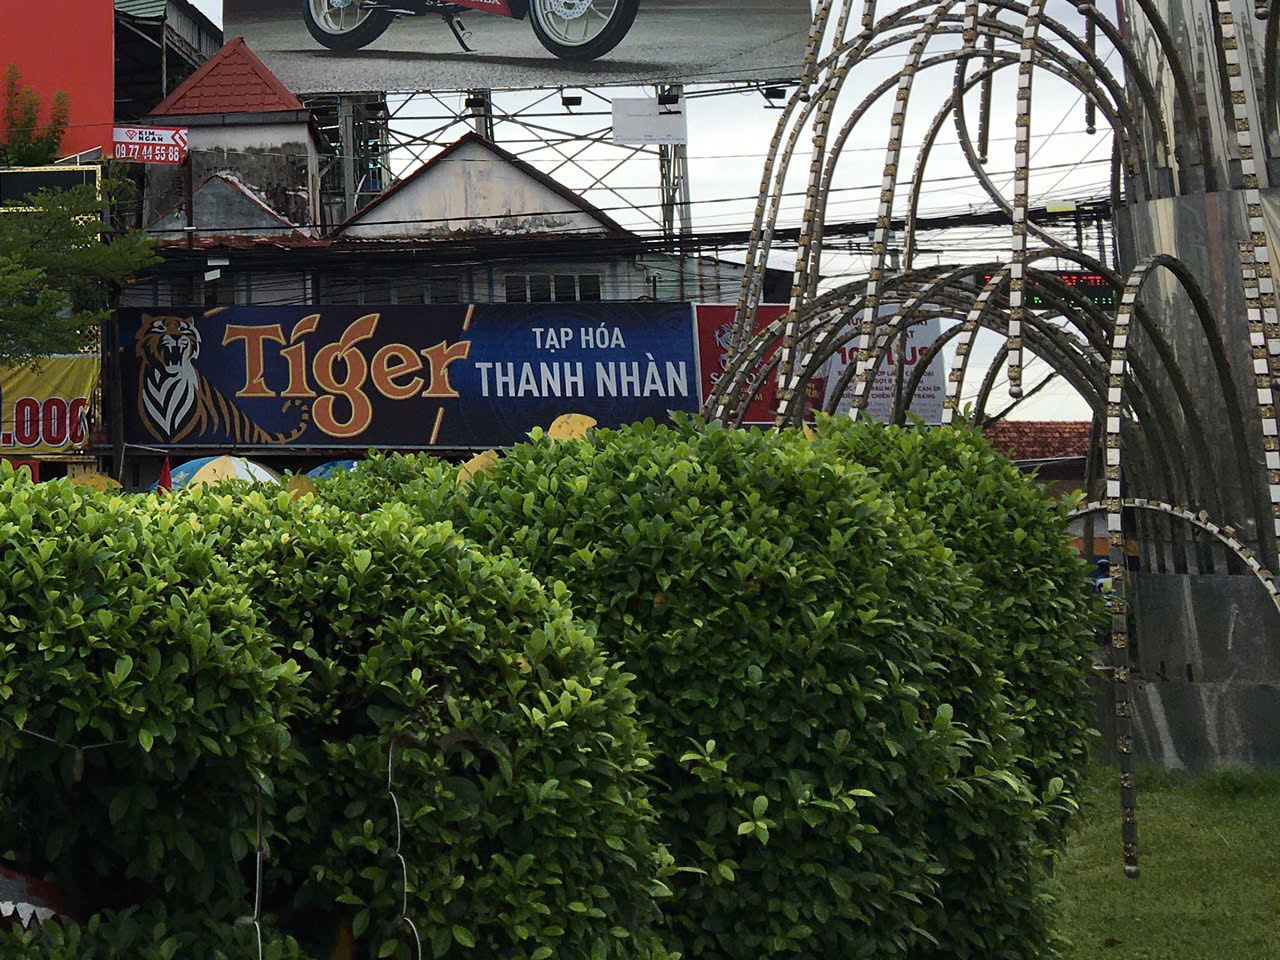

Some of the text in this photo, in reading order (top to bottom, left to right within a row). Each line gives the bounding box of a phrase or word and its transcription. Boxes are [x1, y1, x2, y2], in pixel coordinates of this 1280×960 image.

[115, 144, 126, 158] 09
[128, 145, 139, 159] 77
[142, 145, 152, 160] 44
[155, 146, 166, 160] 55
[531, 322, 626, 353] TẠP HÓA
[221, 312, 472, 438] Tiger
[475, 361, 585, 397] THANH
[595, 352, 689, 397] NHÀN
